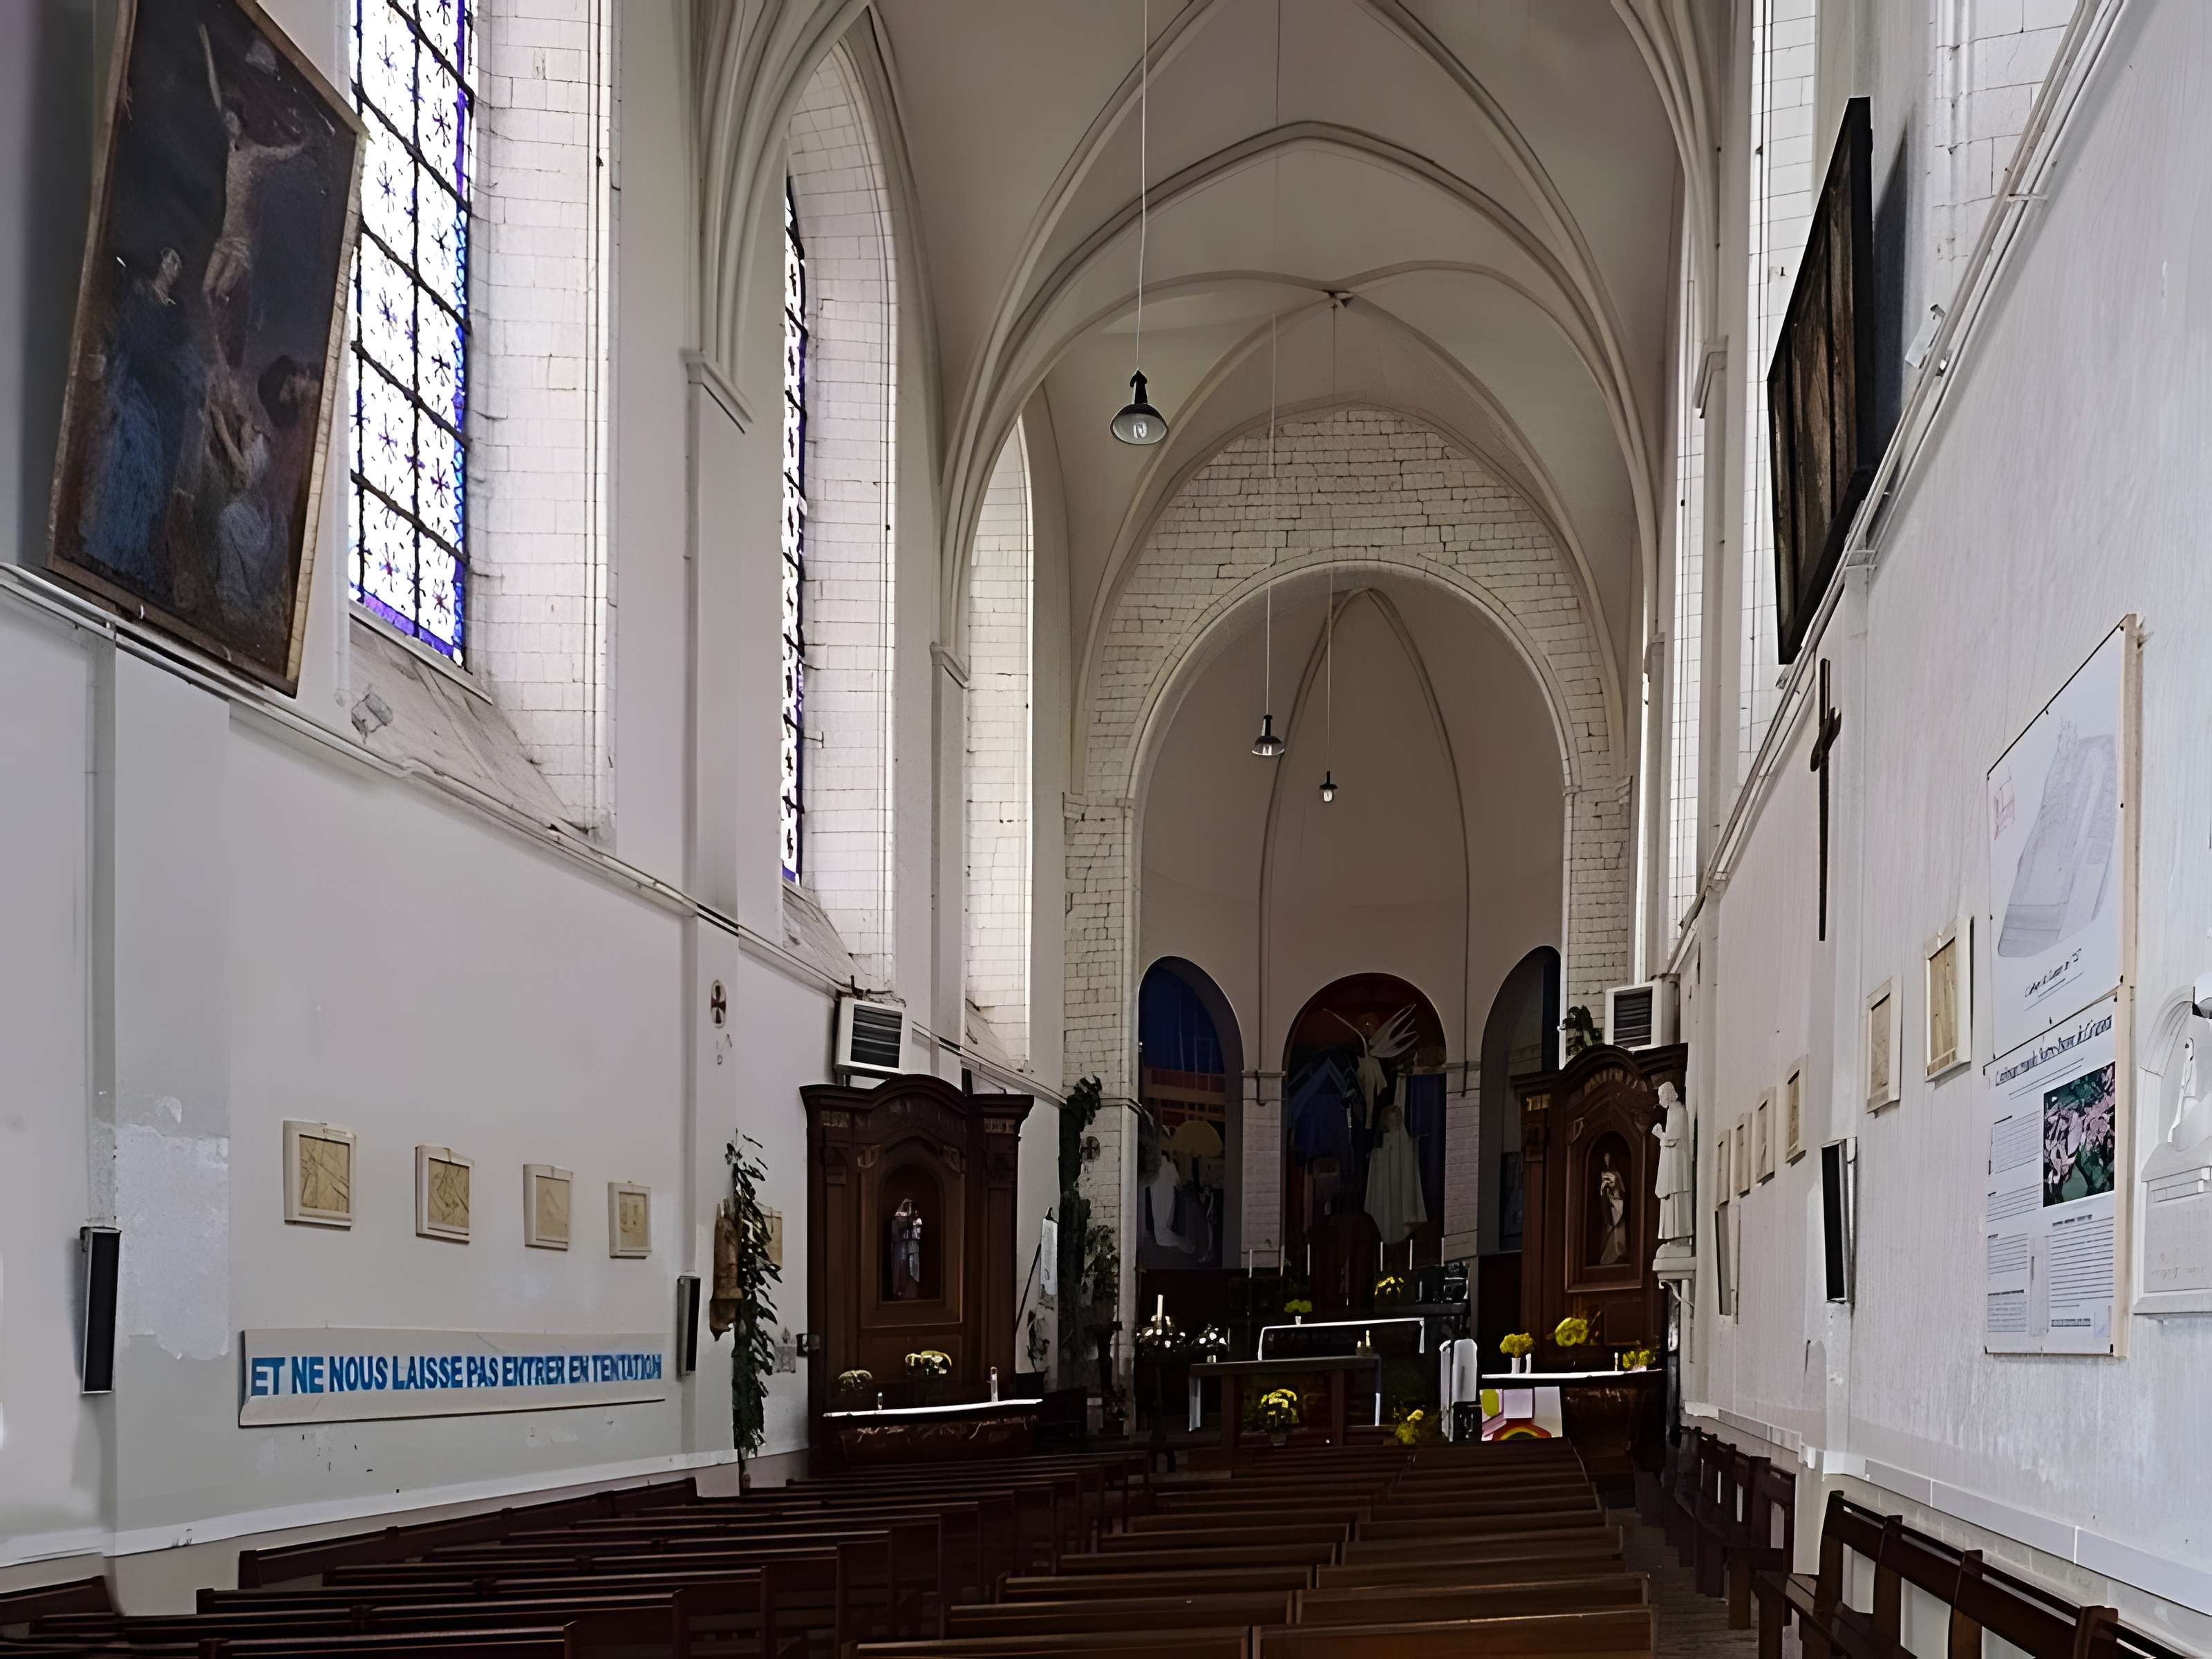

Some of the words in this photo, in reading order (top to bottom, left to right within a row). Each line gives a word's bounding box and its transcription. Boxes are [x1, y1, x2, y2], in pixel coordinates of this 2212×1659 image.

[250, 1357, 285, 1396] ET
[291, 1356, 324, 1394] NE
[329, 1356, 388, 1392] NOUS
[392, 1356, 462, 1390] LAISSE
[467, 1356, 498, 1387] PAS
[502, 1356, 565, 1387] ENTRER
